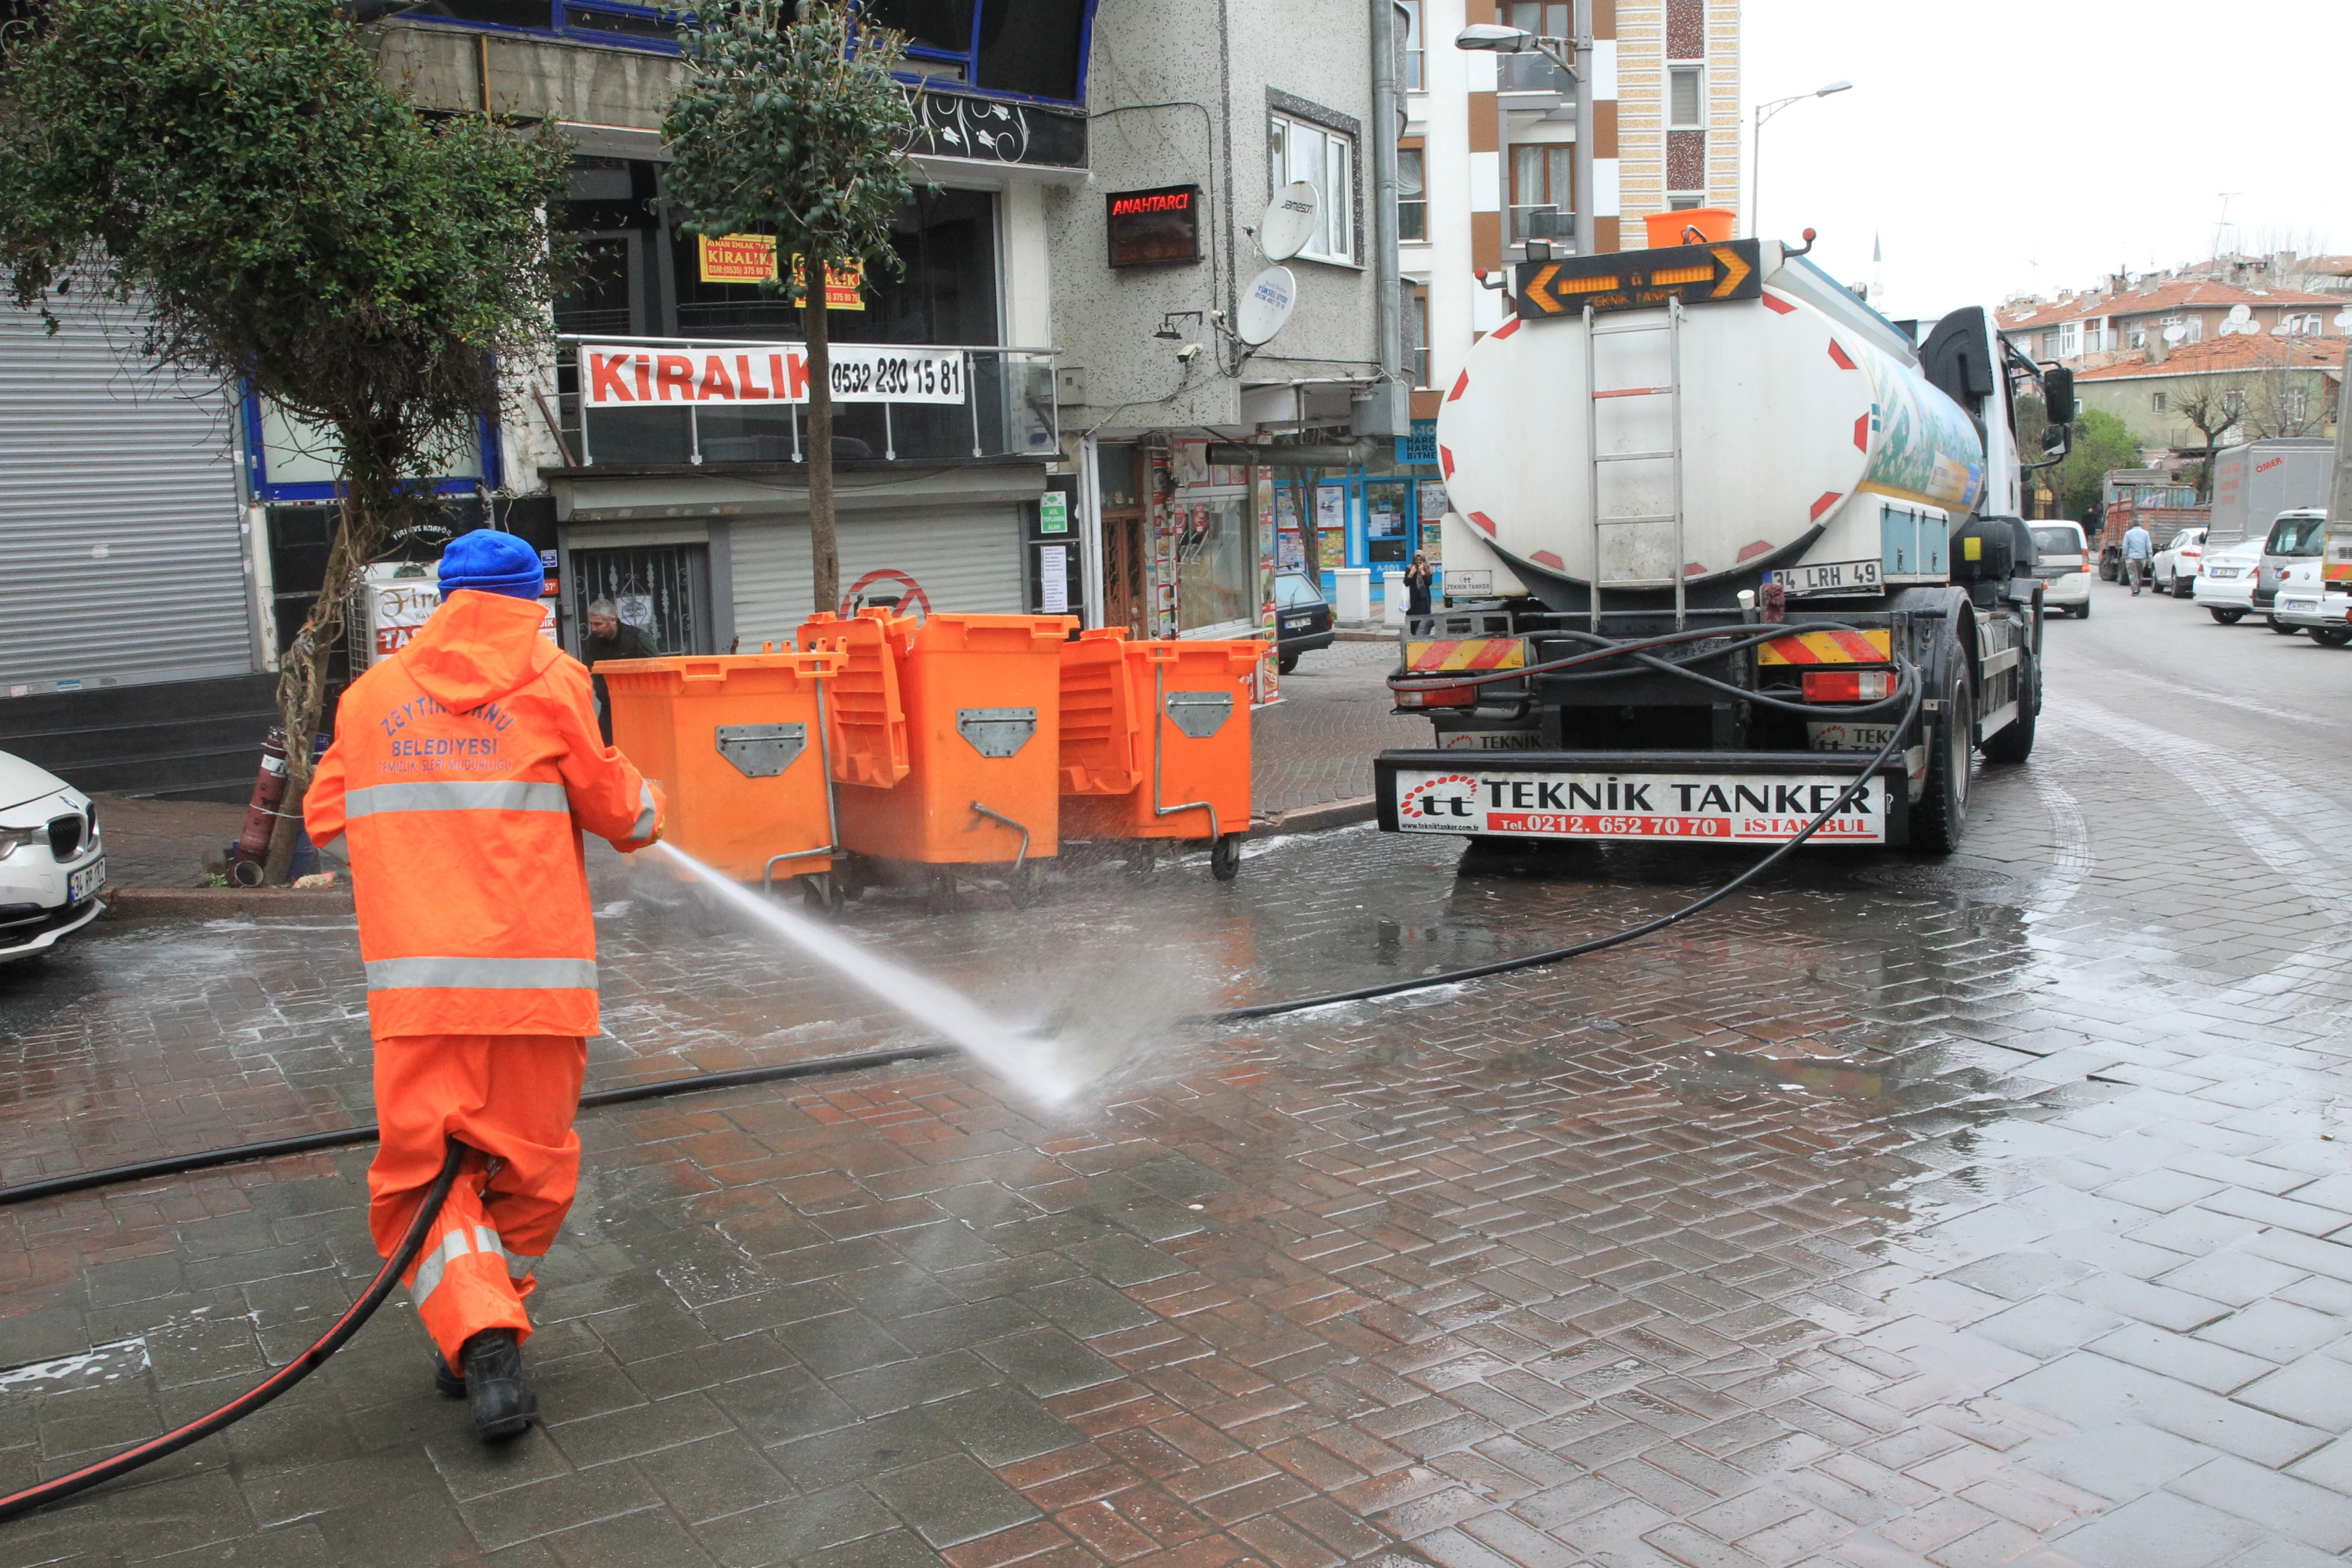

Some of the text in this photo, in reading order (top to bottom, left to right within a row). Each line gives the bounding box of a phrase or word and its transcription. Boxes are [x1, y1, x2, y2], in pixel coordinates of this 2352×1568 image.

[1112, 192, 1190, 216] ANAHTARCI
[1281, 199, 1313, 214] Jameson
[833, 293, 844, 301] 375
[832, 362, 871, 393] 0532
[875, 358, 907, 393] 230
[914, 359, 935, 395] 15
[941, 359, 959, 395] 81
[2255, 457, 2282, 473] ÖMER
[1773, 563, 1876, 589] 34 LRH 49
[392, 734, 498, 756] BELEDİYESİ
[1482, 777, 1654, 812] TEKNİK
[1671, 783, 1872, 814] TANKER
[1401, 822, 1479, 831] www.tekniktanker.com.tr
[1598, 817, 1642, 834] 652
[1650, 818, 1680, 835] 70
[1688, 818, 1717, 836] 70
